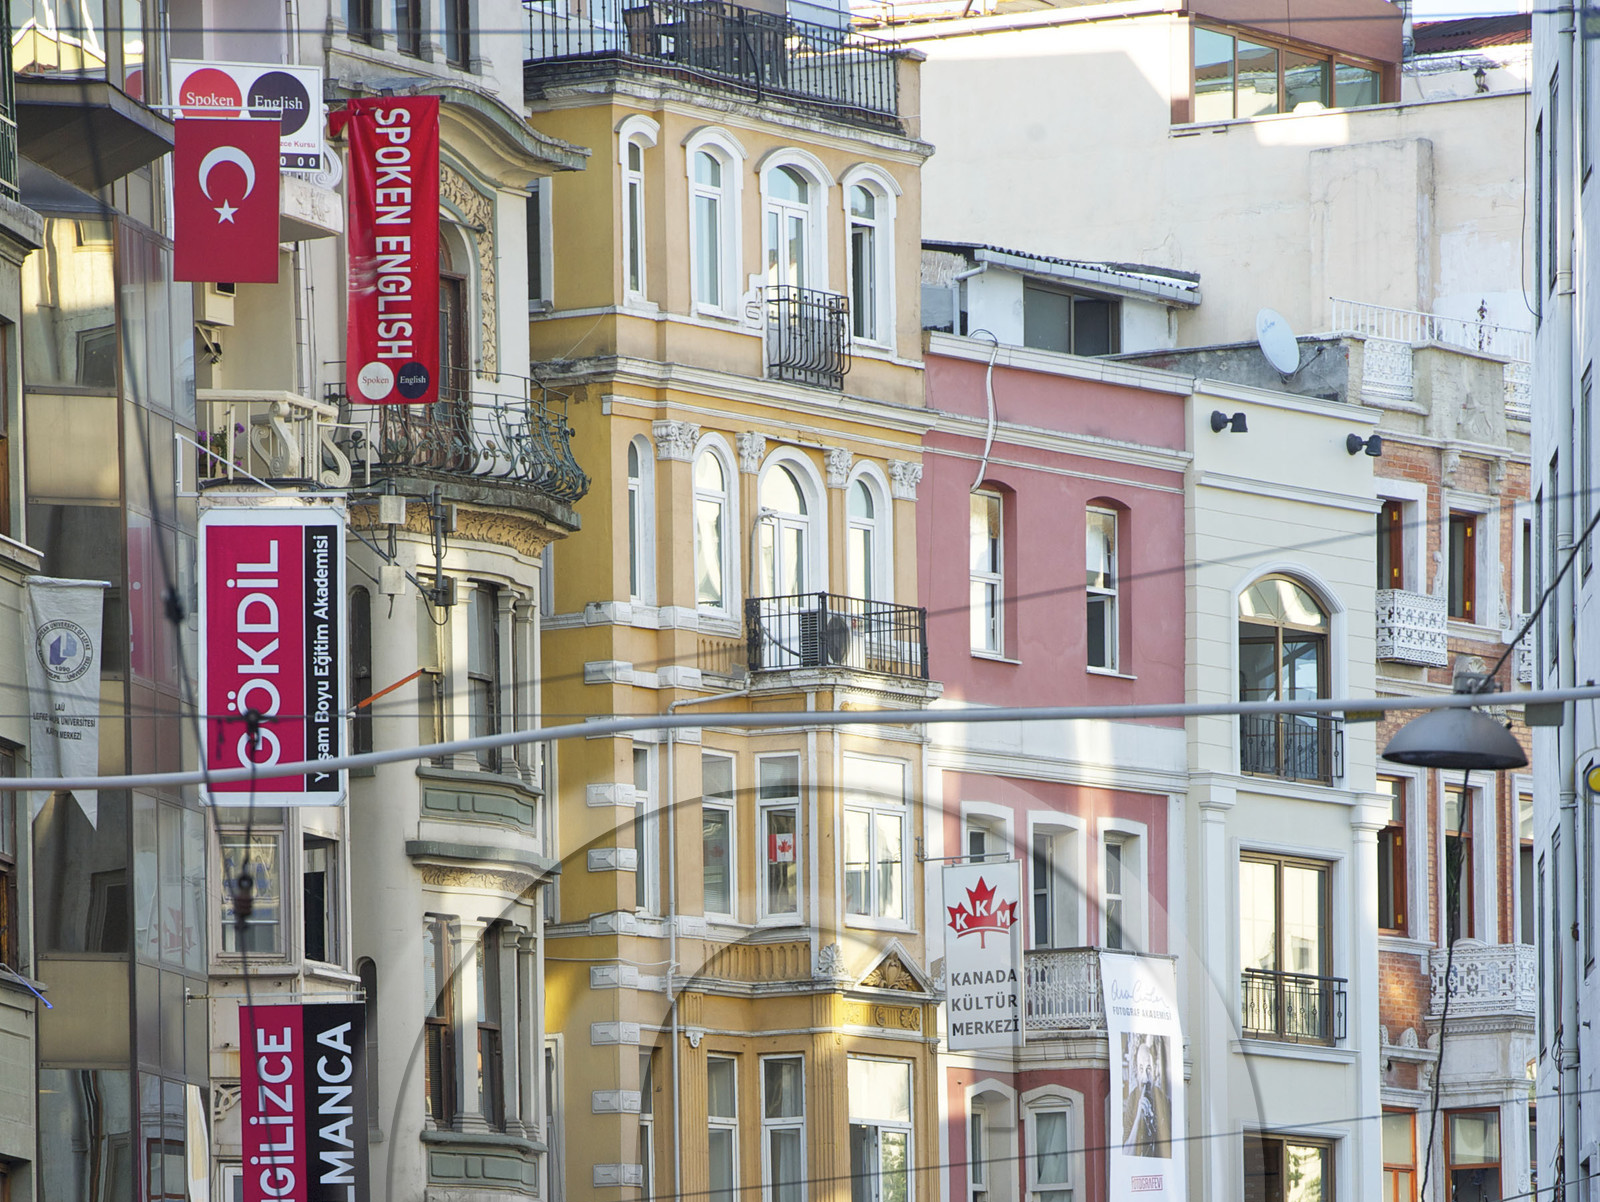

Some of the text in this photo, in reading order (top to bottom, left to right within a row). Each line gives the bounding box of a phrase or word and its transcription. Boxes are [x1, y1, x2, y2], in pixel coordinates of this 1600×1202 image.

[186, 91, 304, 110] Spoken English
[293, 140, 316, 148] Kursu
[374, 107, 413, 359] SPOKEN ENGLISH
[362, 375, 427, 387] Spoken English
[226, 539, 281, 770] GÖKDİL
[312, 535, 333, 783] Yşam Boyu Eğitim Akademisi
[952, 969, 1017, 987] KANADA
[952, 992, 1018, 1012] KÜLTÜR
[952, 1015, 1020, 1037] MERKEZİ
